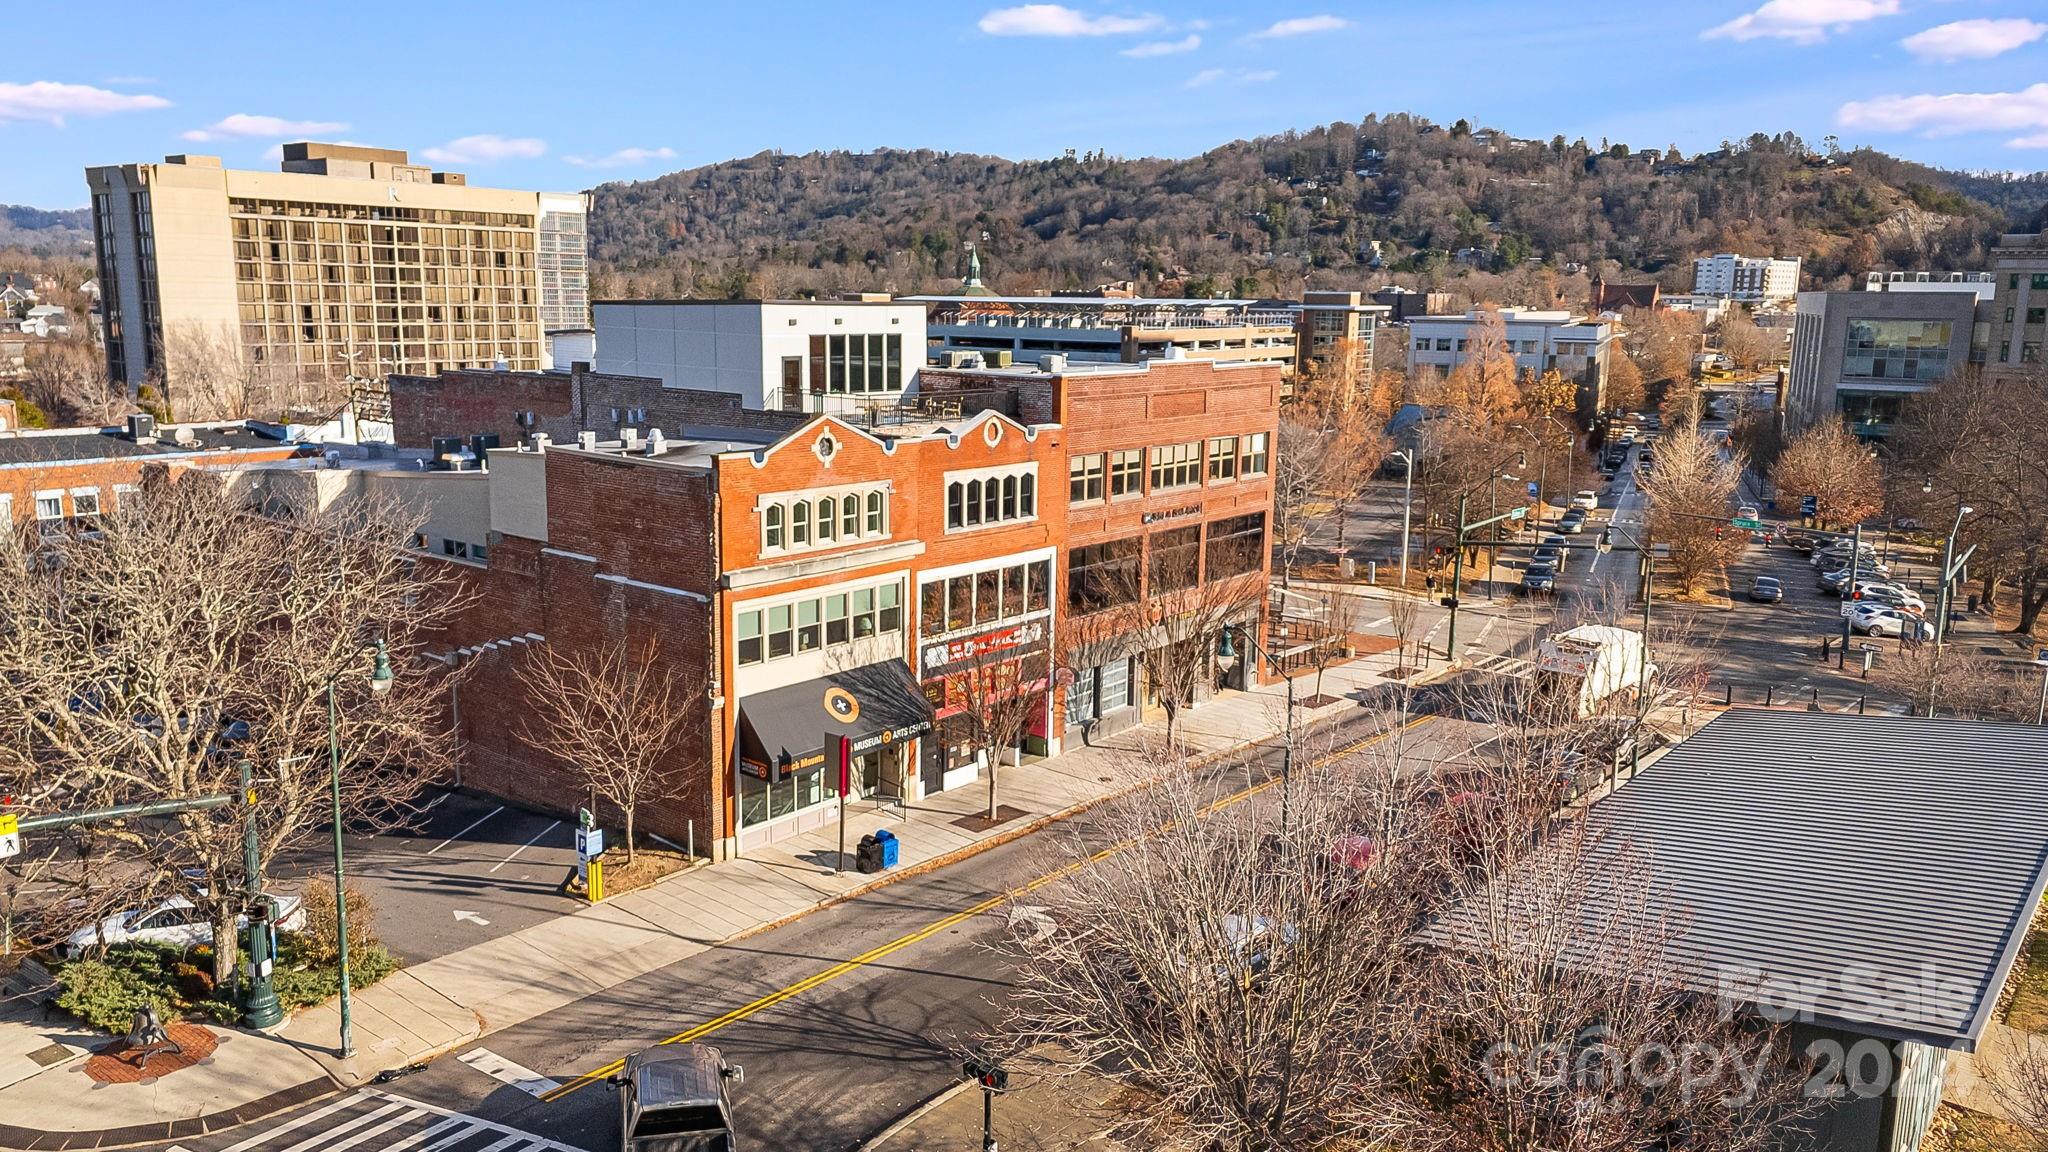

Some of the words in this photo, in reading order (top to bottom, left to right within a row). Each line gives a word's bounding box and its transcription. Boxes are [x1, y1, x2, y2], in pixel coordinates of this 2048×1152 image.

[853, 735, 882, 752] MUSEUM
[892, 727, 908, 740] ARTS
[781, 760, 800, 774] Black
[580, 838, 586, 850] P
